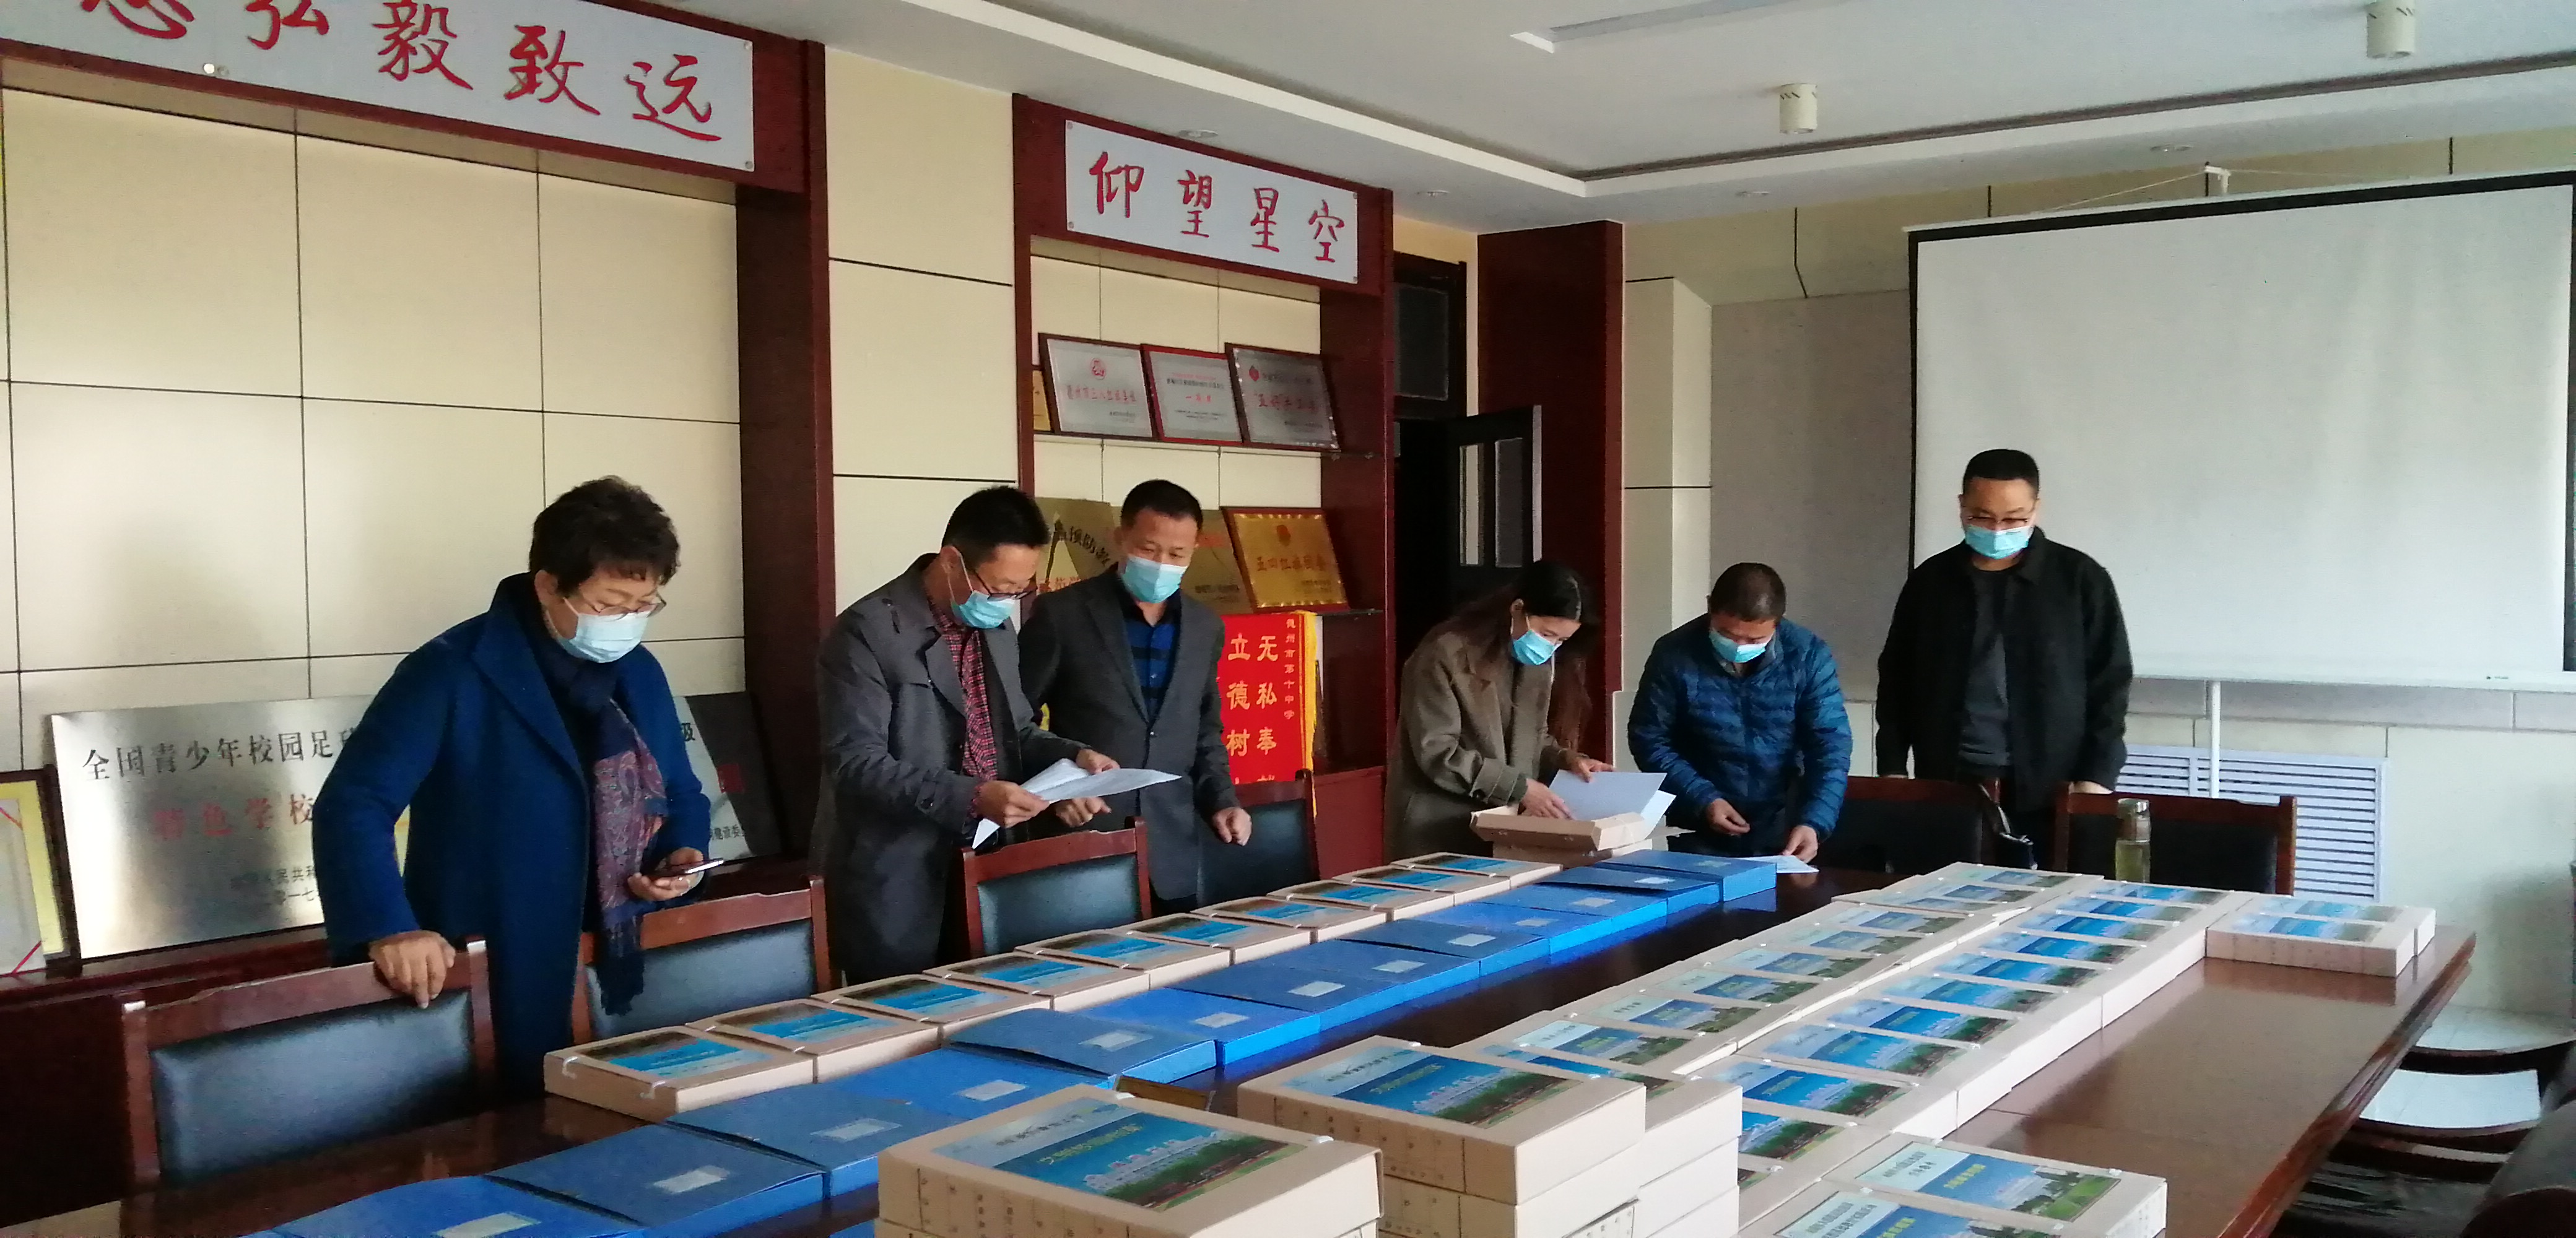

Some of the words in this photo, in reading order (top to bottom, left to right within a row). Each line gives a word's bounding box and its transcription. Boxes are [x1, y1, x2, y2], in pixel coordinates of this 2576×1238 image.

[1088, 151, 1345, 262] 仰望星空
[1226, 633, 1251, 784] 立德树
[1256, 635, 1279, 782] 无私奉
[1284, 618, 1296, 720] 德州市第十中学
[152, 793, 314, 839] 特色学校
